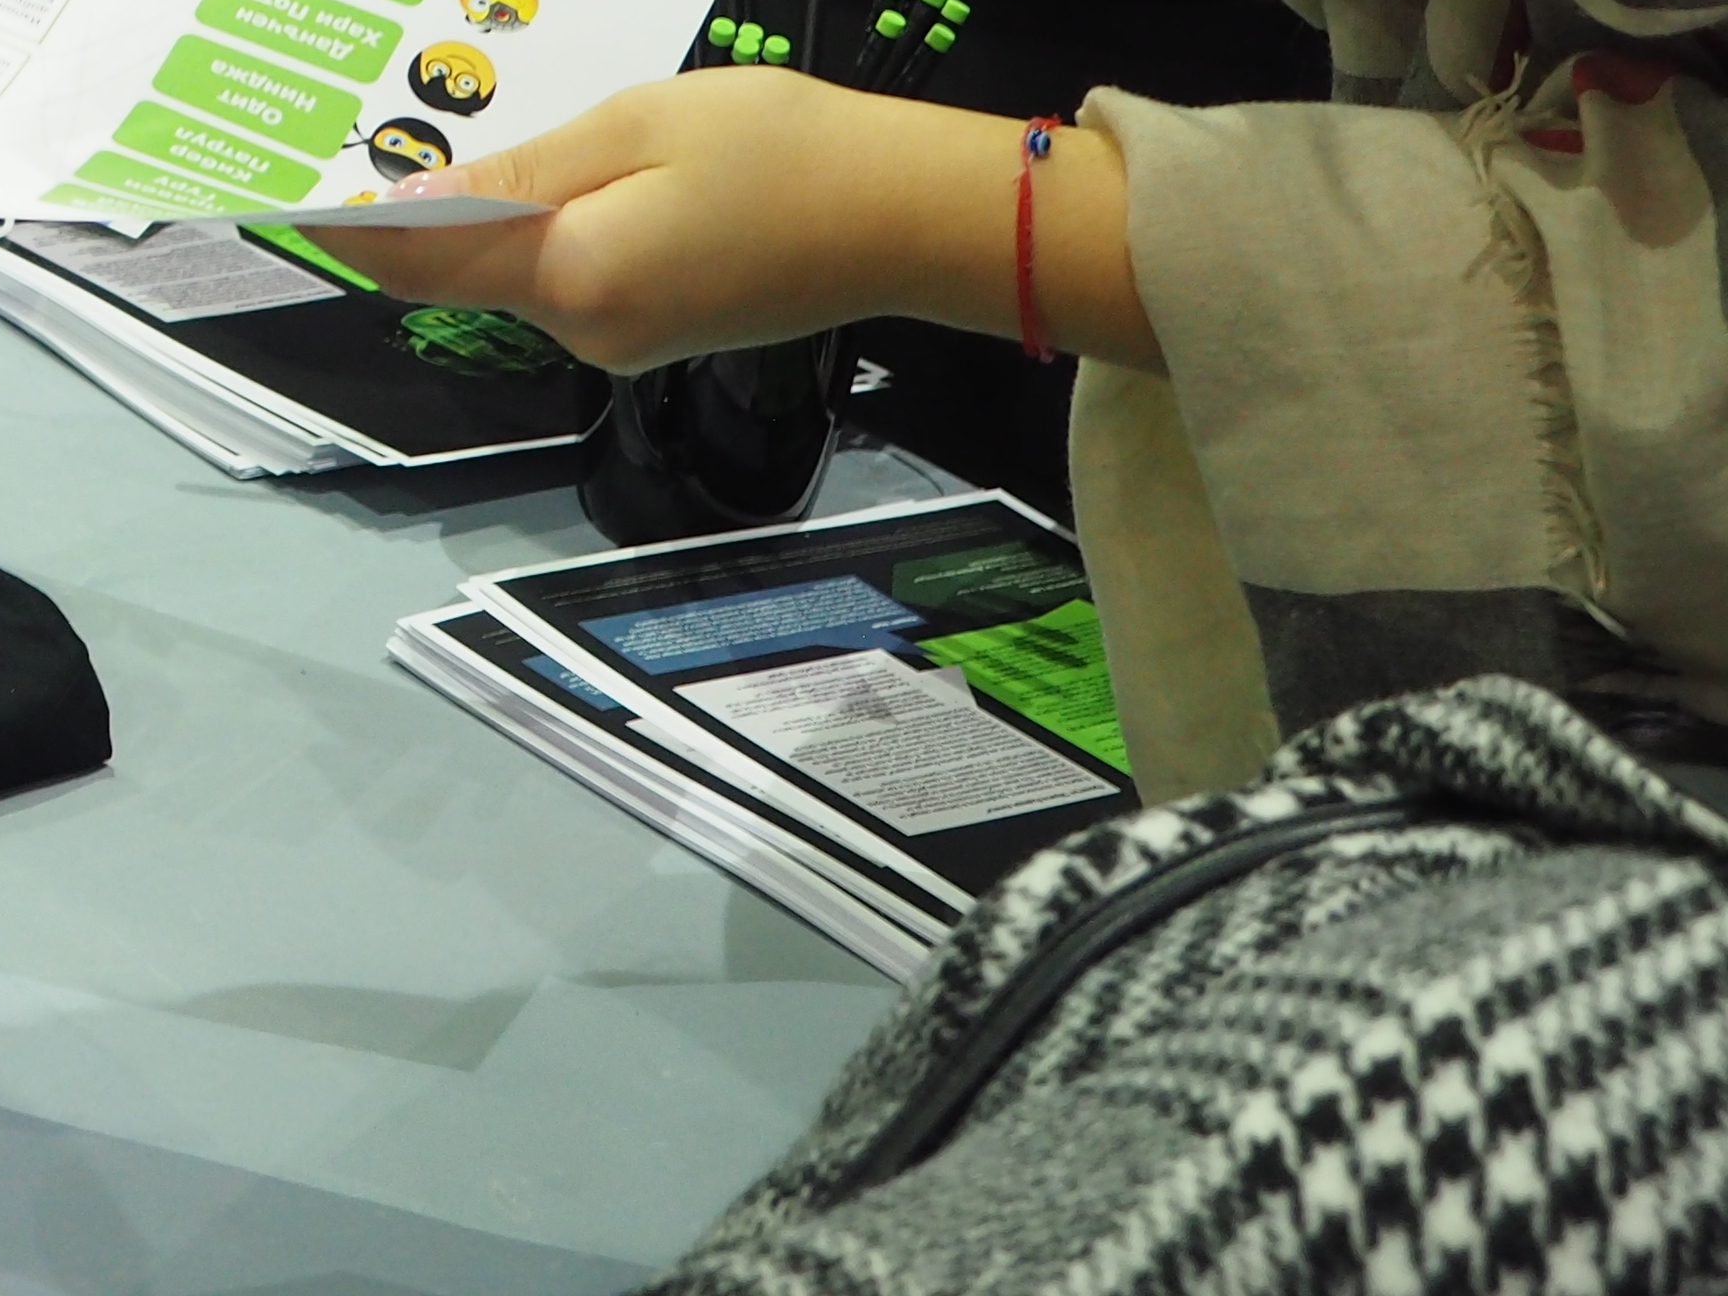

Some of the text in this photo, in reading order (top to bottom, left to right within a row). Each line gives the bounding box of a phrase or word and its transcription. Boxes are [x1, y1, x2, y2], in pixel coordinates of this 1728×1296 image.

[235, 6, 355, 62] Данъчен
[316, 7, 384, 48] Хари
[209, 58, 319, 114] Нинджа
[218, 89, 284, 127] Одит
[168, 143, 253, 184] Кибер
[172, 125, 271, 175] Патрул
